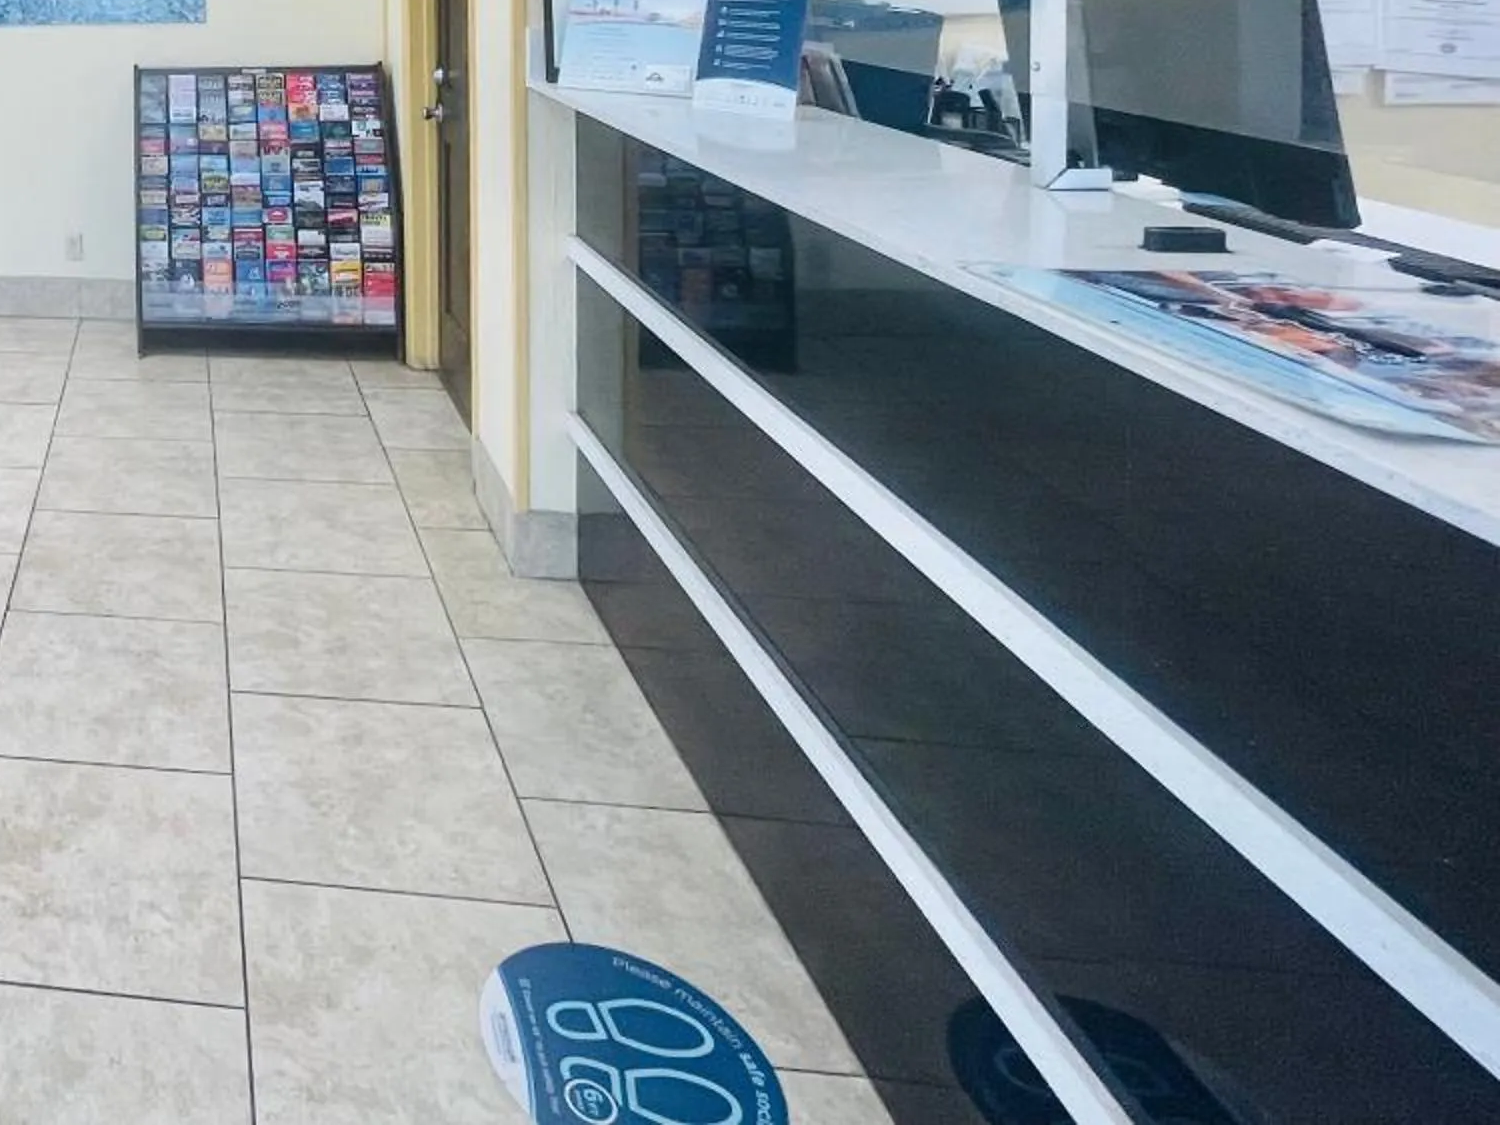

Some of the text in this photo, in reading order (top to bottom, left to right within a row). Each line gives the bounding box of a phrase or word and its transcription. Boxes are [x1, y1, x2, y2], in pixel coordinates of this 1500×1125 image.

[612, 956, 672, 990] Please
[674, 987, 744, 1050] maintain
[739, 1051, 766, 1087] safe
